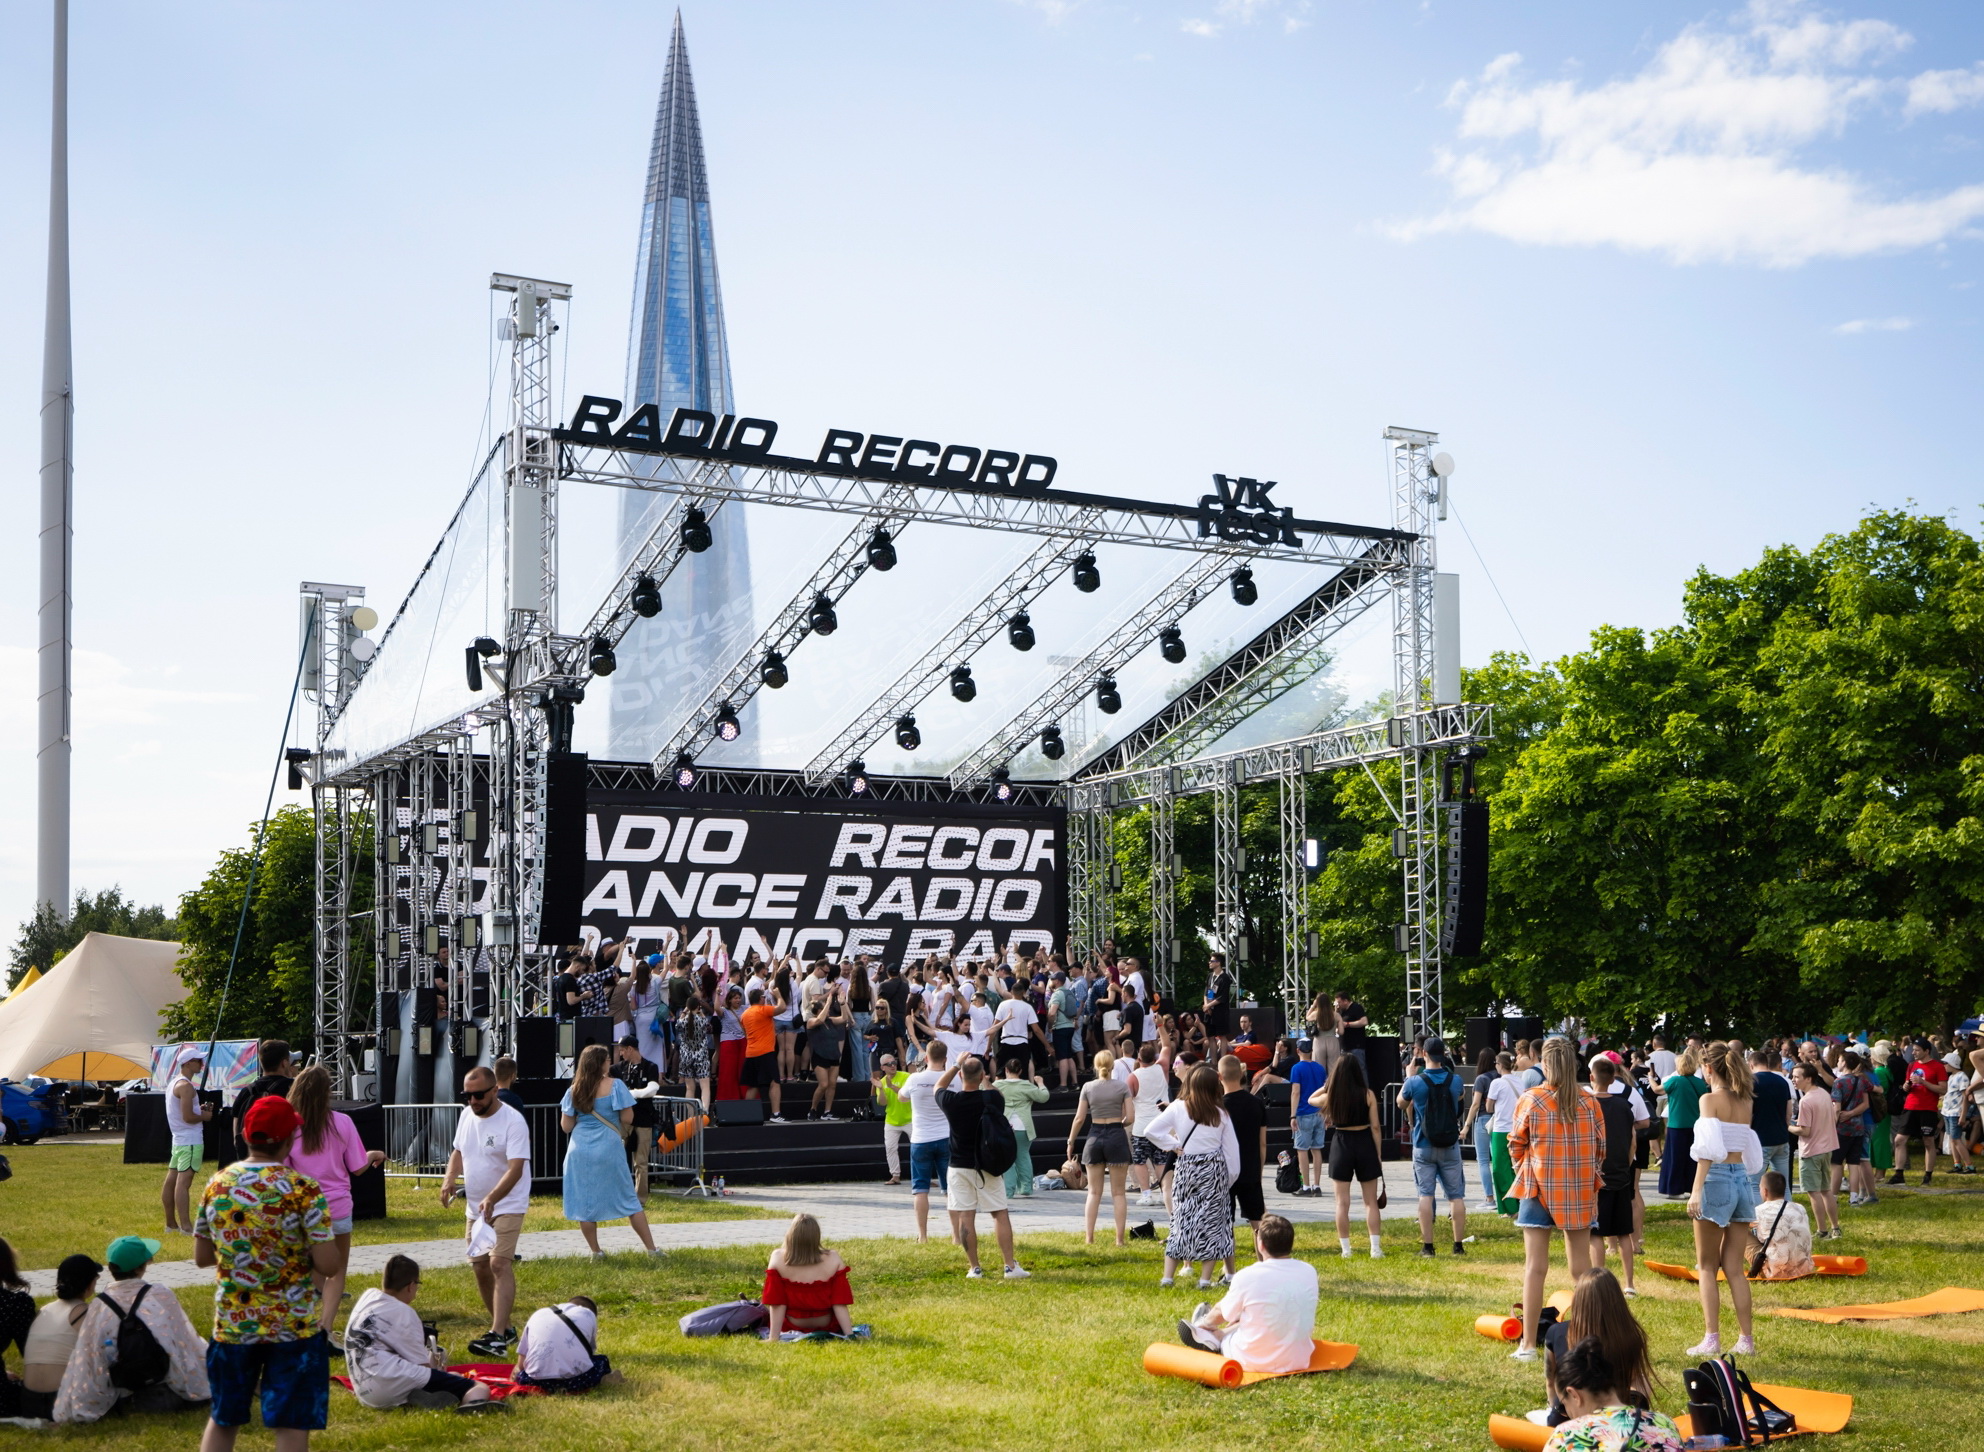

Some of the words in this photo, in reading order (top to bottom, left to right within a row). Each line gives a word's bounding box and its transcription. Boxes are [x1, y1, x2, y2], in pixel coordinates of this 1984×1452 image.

[568, 395, 778, 456] RADIO
[815, 428, 1057, 490] RECORD
[1212, 473, 1278, 512] VK
[1197, 494, 1303, 547] fest
[814, 874, 1043, 922] RADIO
